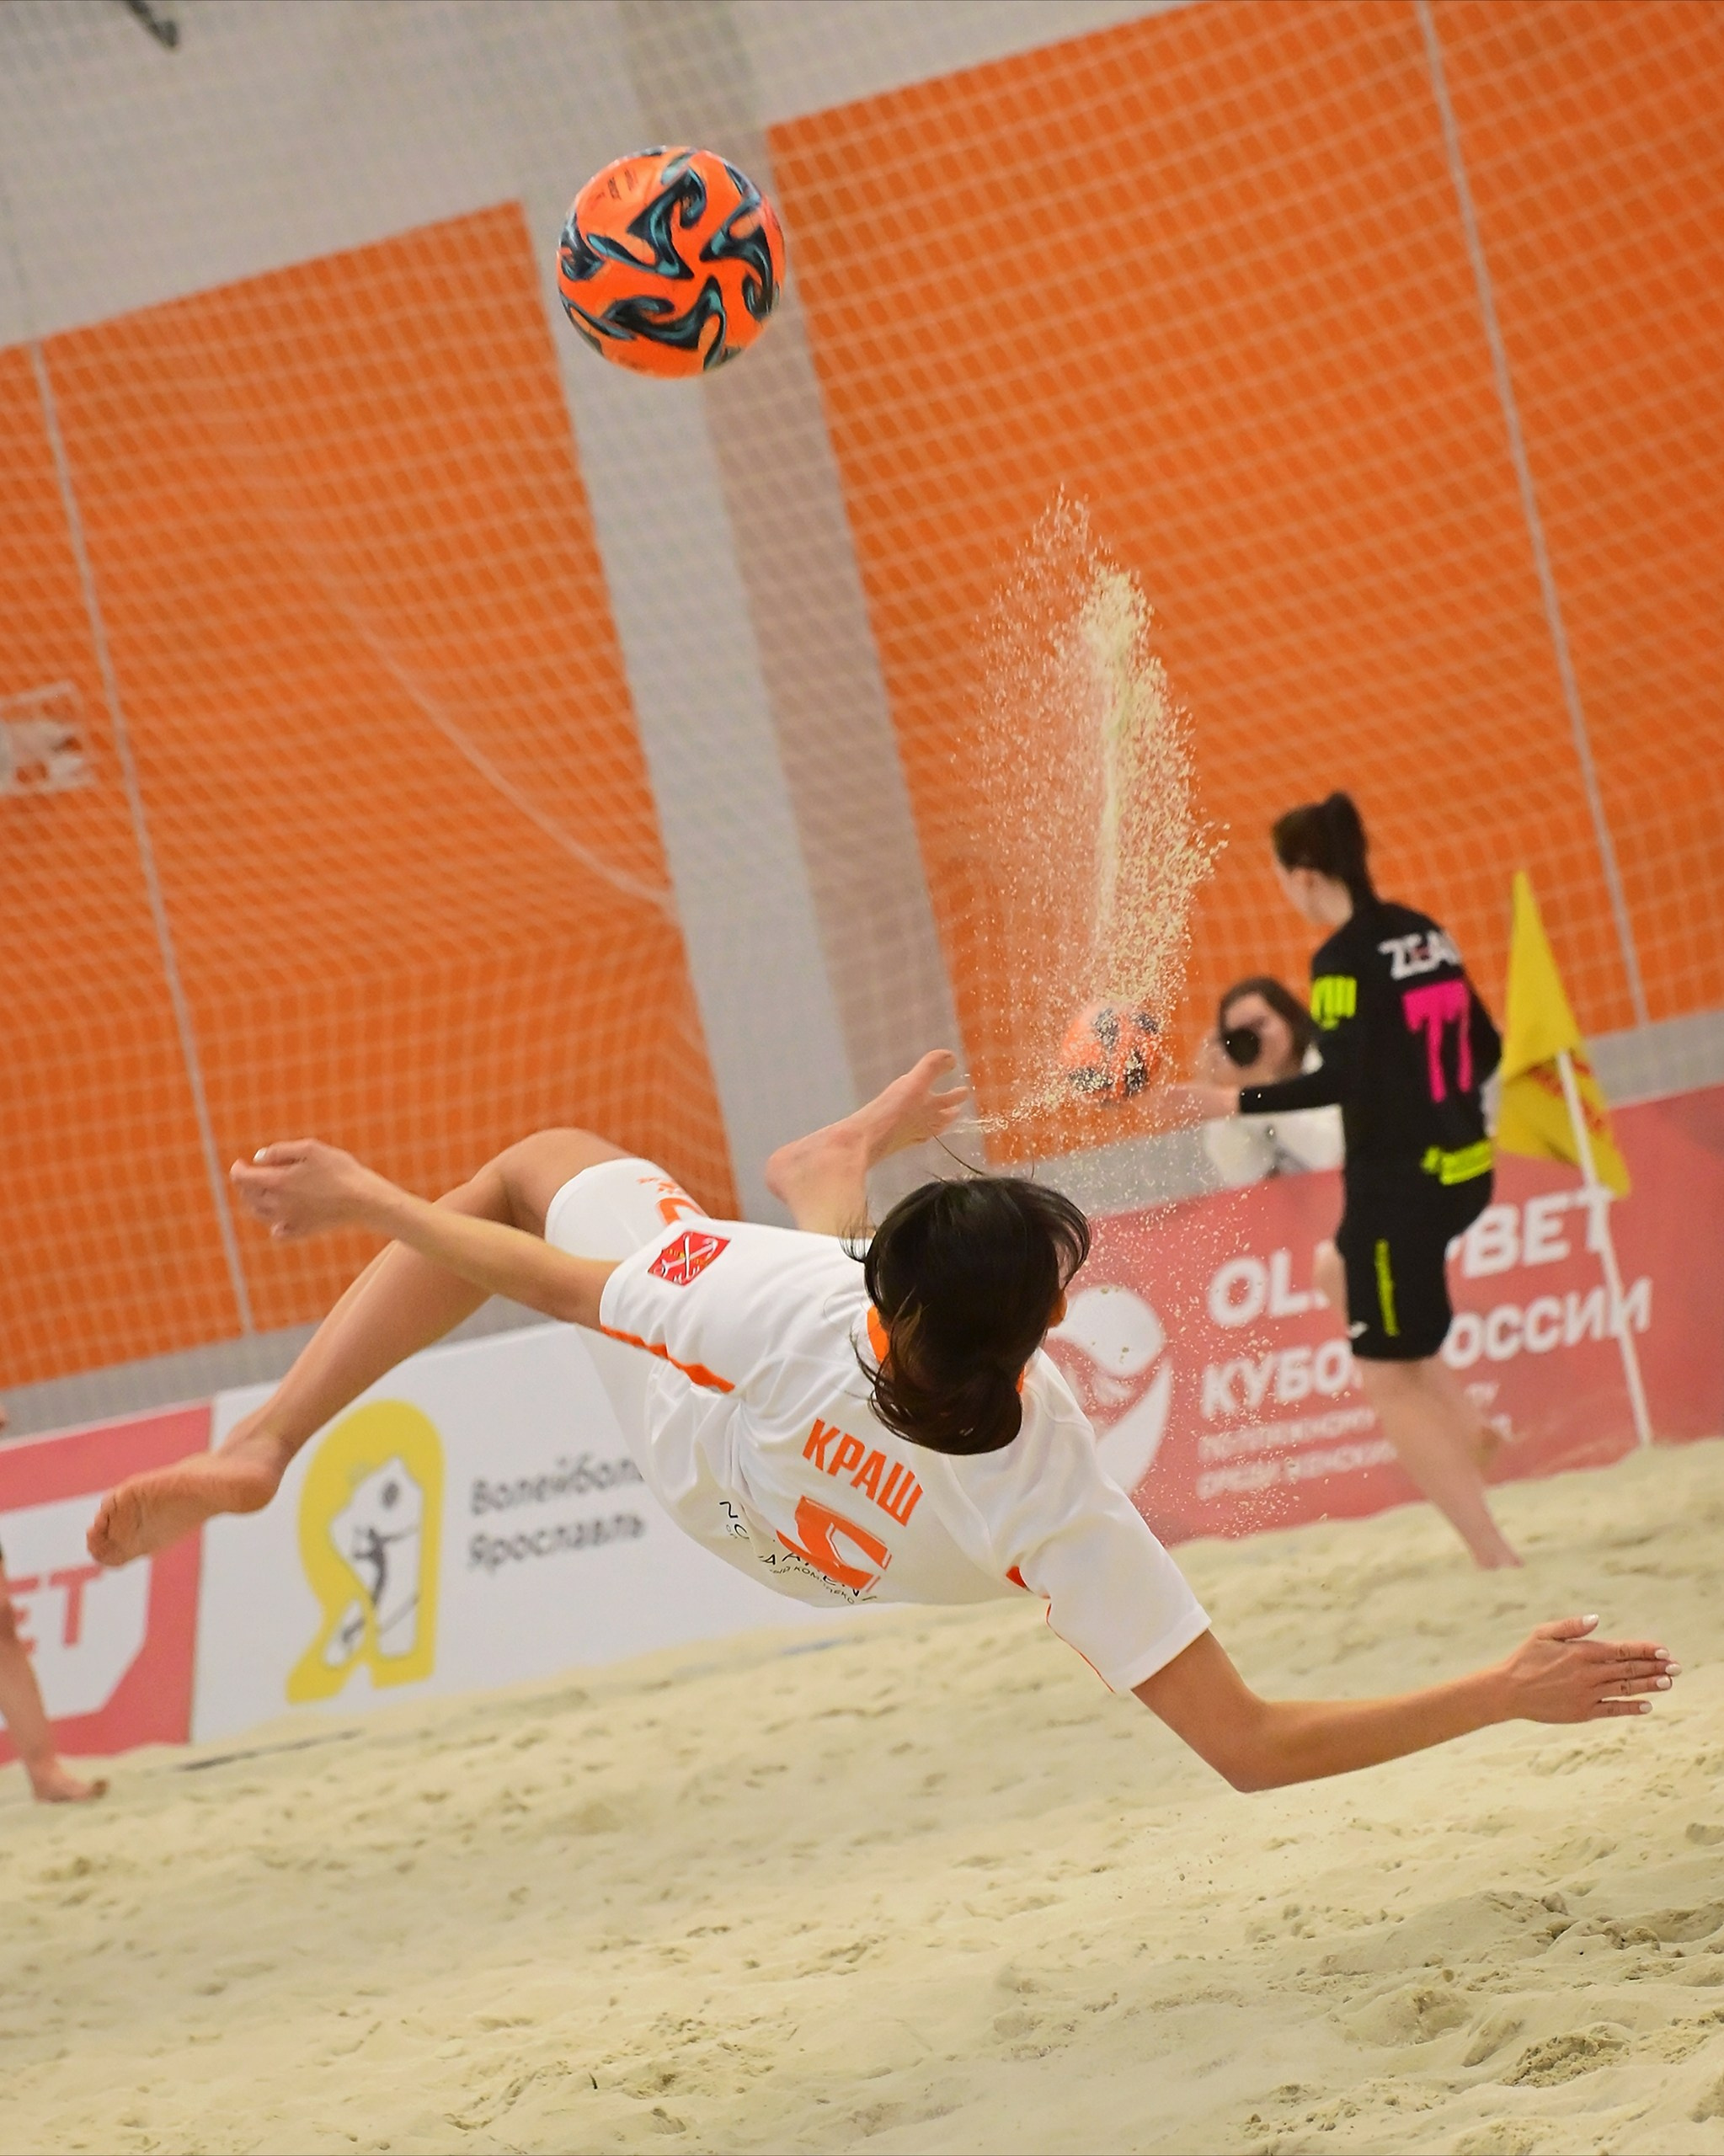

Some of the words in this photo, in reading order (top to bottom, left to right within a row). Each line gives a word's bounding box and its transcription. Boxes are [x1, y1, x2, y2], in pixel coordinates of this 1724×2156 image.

[1401, 978, 1474, 1104] 77
[1208, 1184, 1615, 1327] OLBET
[1199, 1338, 1364, 1419] КУБО
[1439, 1277, 1654, 1370] ОССИИ
[802, 1417, 924, 1529] КРАШ
